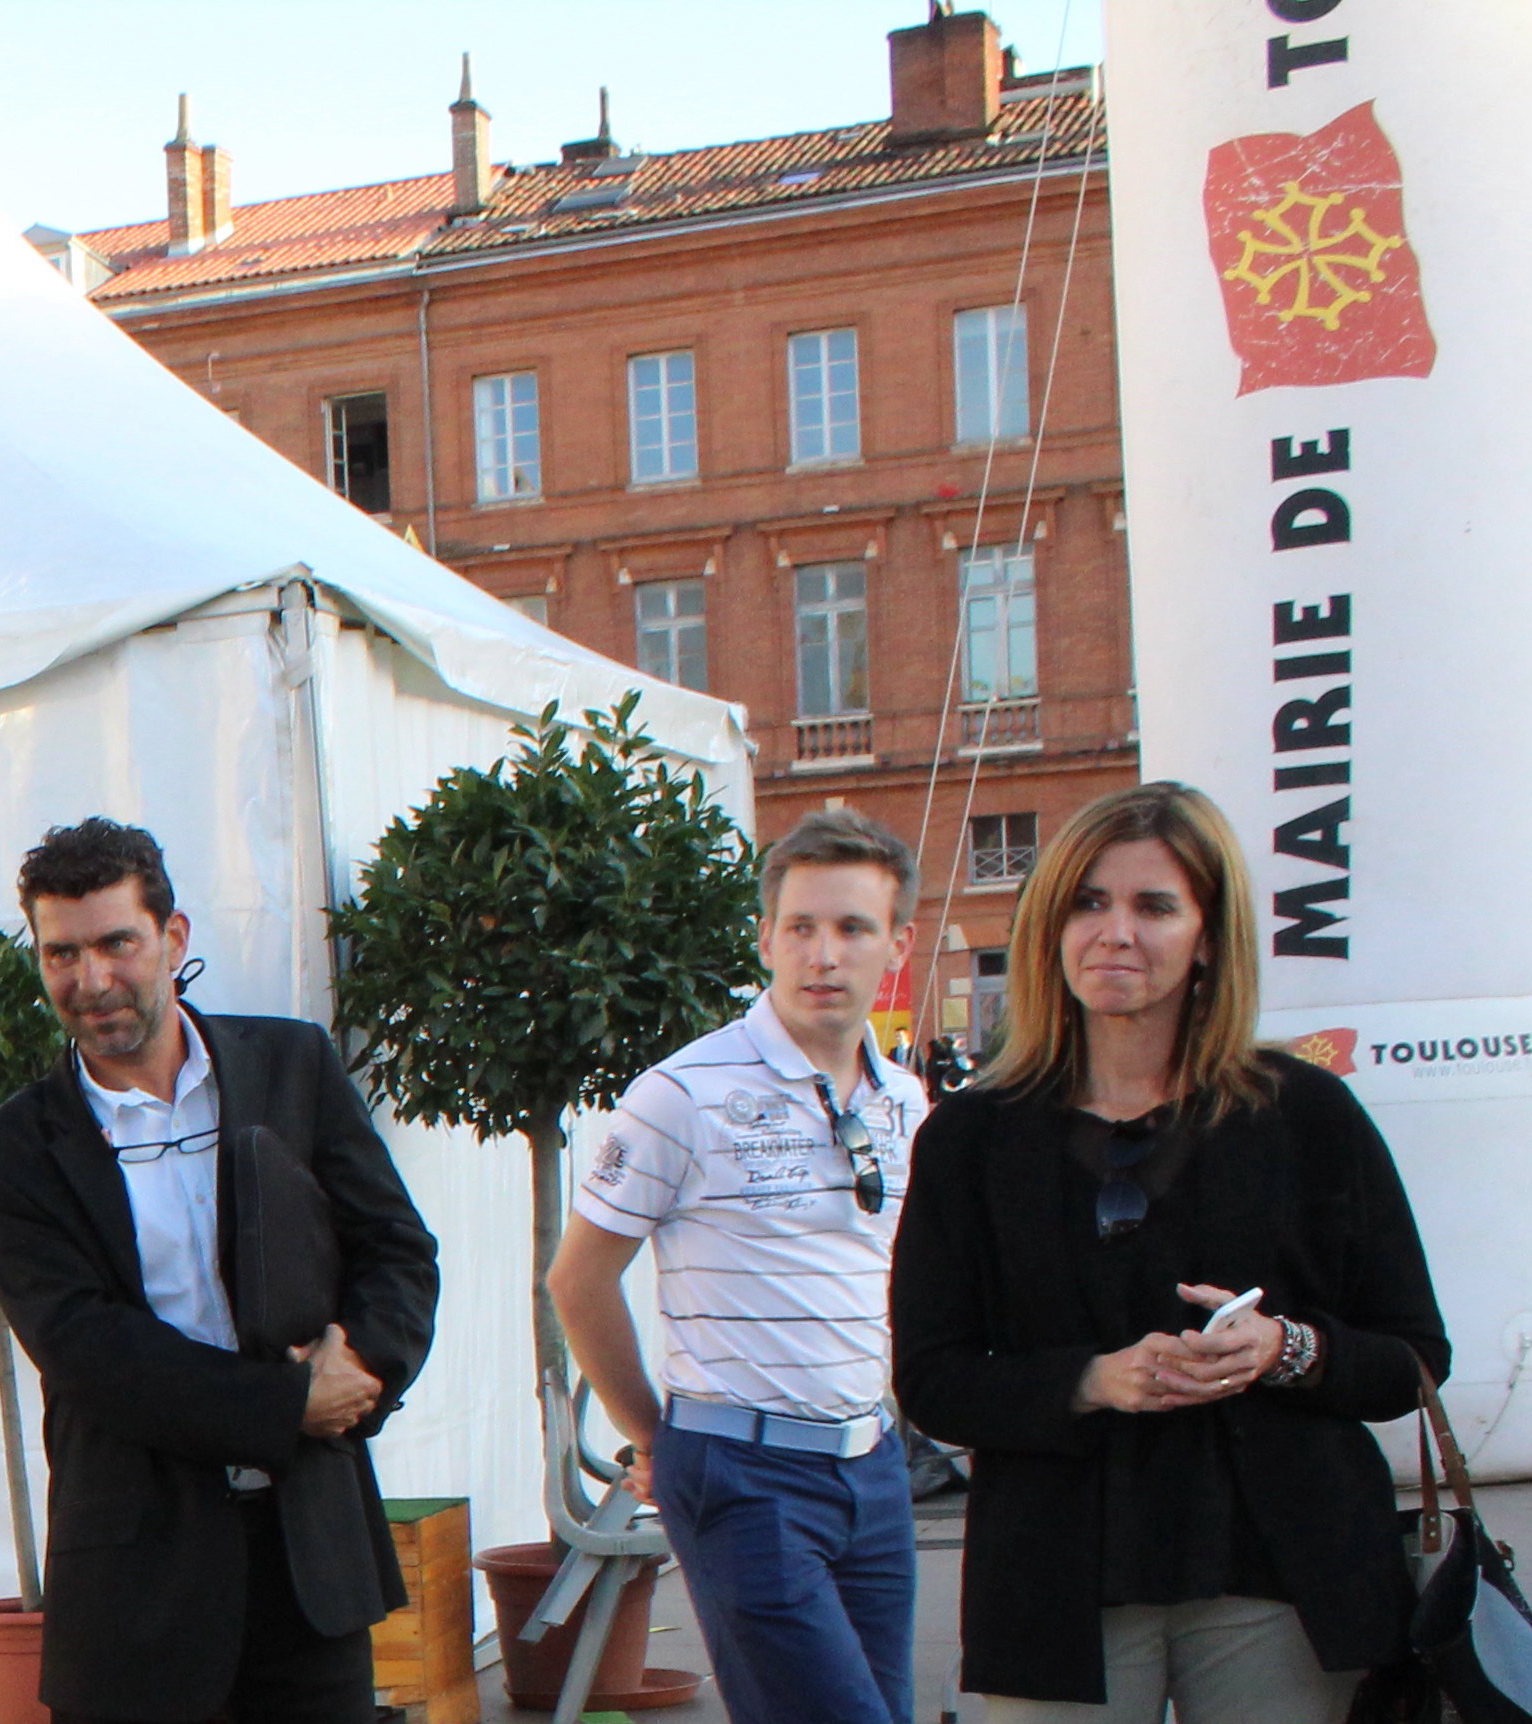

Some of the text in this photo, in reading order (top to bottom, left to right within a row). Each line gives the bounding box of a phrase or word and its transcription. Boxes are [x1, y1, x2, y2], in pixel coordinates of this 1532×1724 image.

[1271, 427, 1351, 552] DE
[1273, 592, 1352, 961] MAIRIE
[734, 1138, 815, 1161] BREAKWATER
